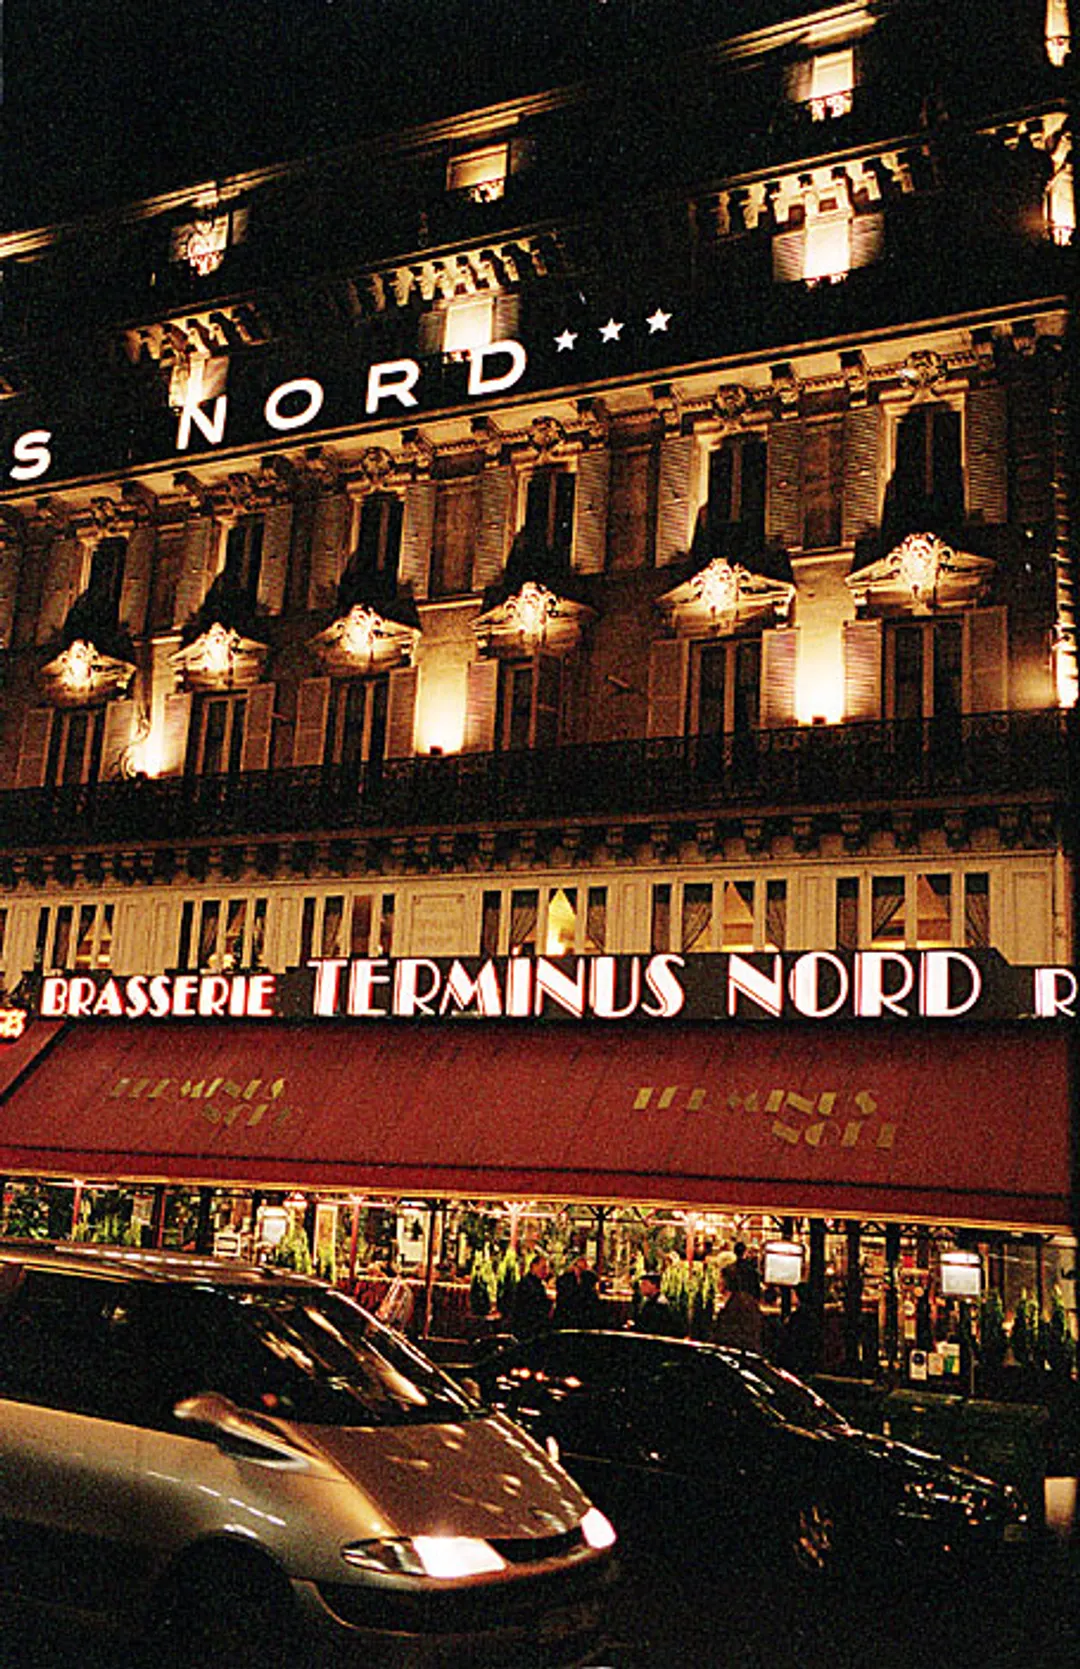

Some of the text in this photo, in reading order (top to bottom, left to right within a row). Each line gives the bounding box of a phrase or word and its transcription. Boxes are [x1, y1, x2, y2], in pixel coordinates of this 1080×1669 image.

[10, 341, 527, 480] S NORD
[40, 951, 1078, 1018] BRASSERIE TERMINUS NORD R
